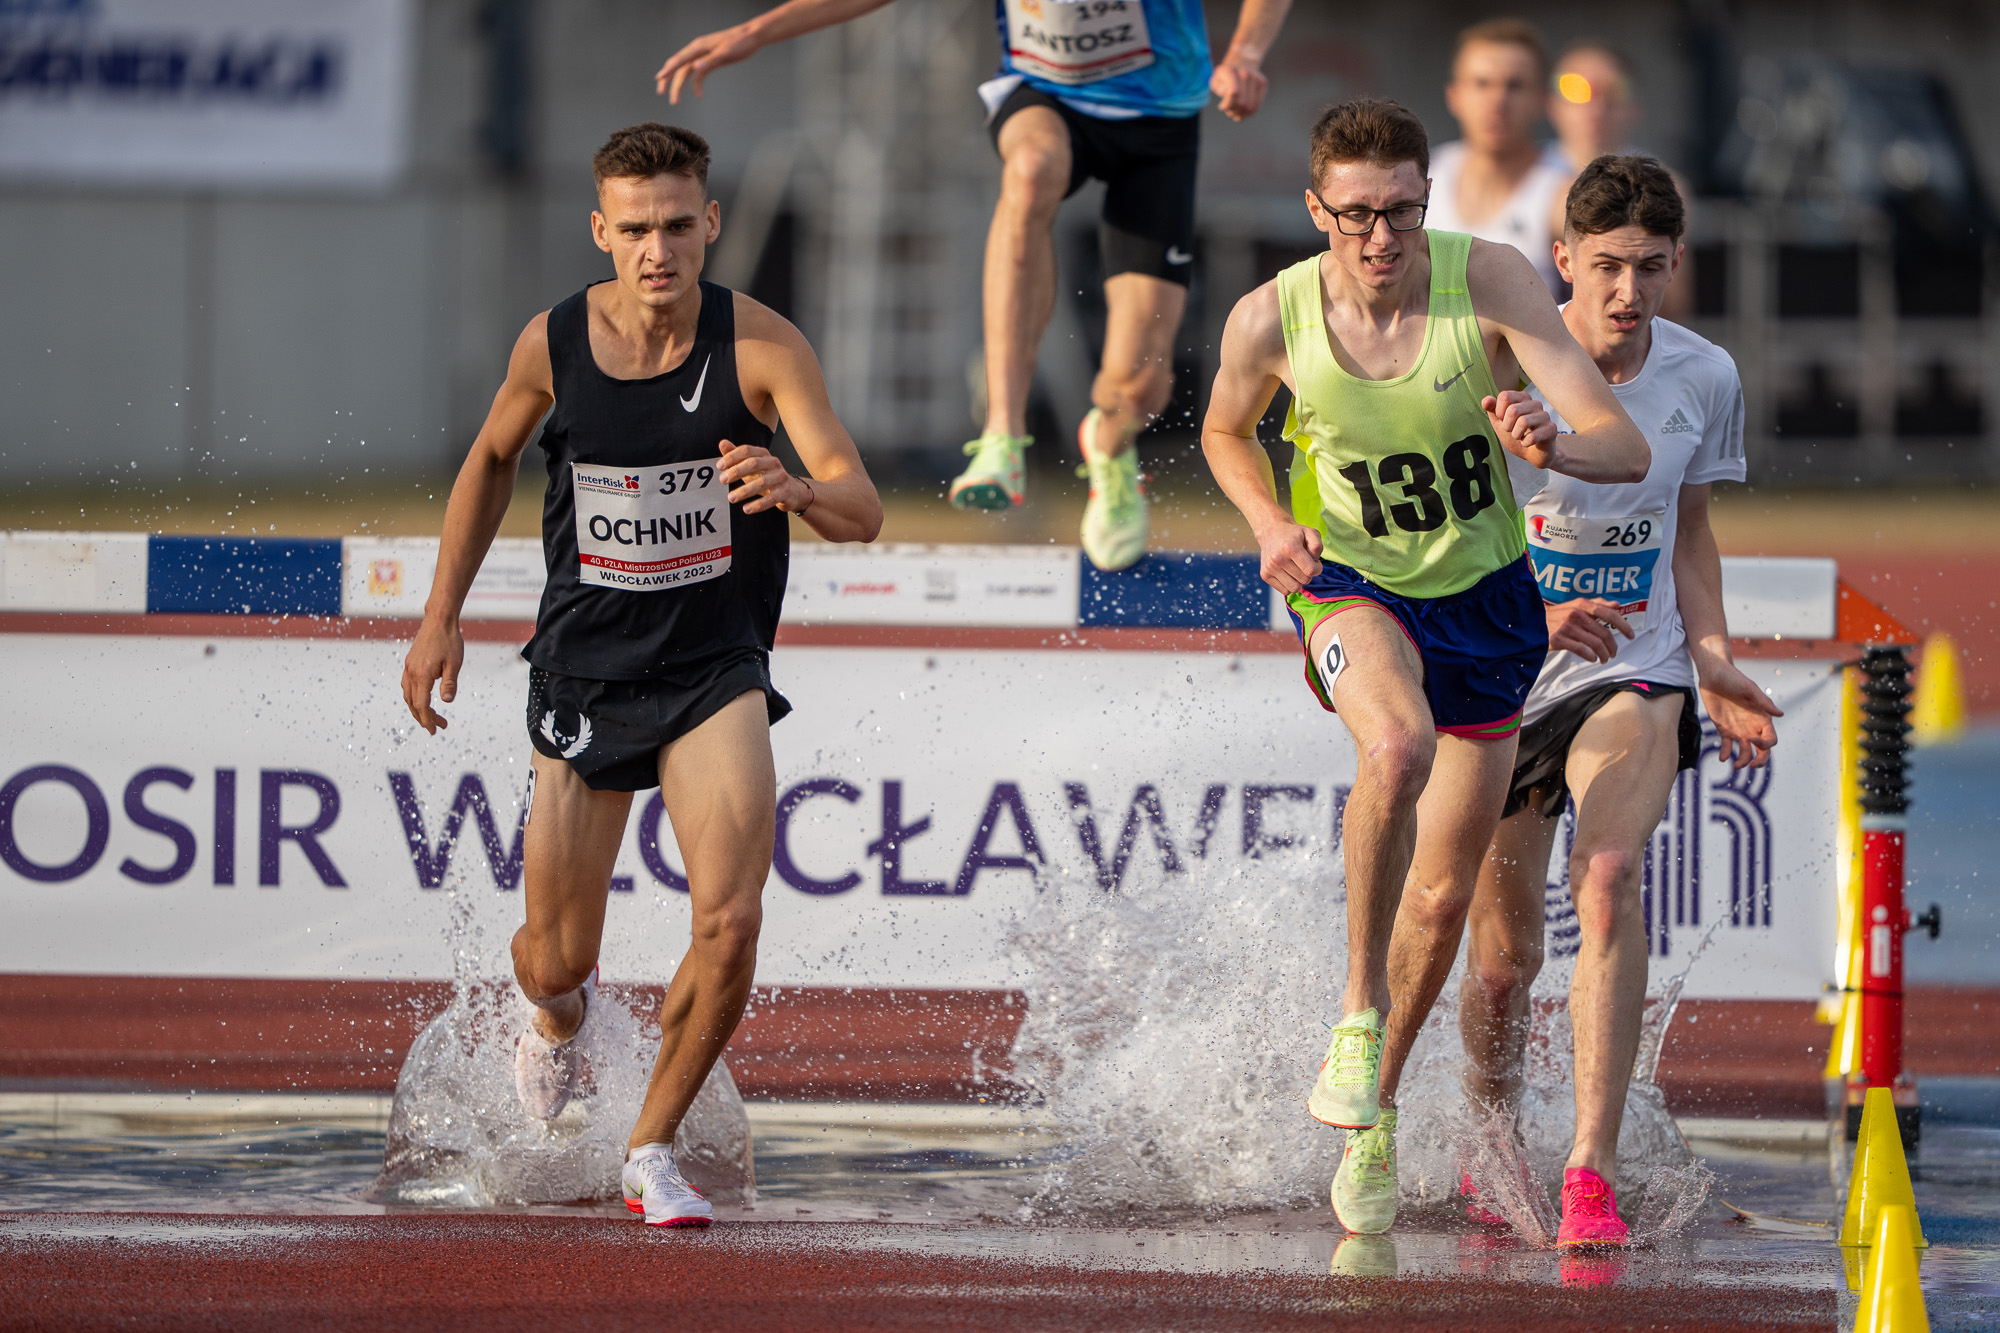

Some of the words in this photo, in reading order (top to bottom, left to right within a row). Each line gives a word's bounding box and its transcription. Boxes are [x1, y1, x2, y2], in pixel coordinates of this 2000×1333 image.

[1023, 24, 1135, 53] ANTOSZ
[1661, 424, 1694, 434] adidas
[577, 472, 624, 488] InterRisk
[658, 465, 715, 495] 379
[1338, 434, 1496, 538] 138
[597, 489, 623, 497] INSURANCE
[589, 507, 717, 546] OCHNIK
[1545, 530, 1578, 541] POMORZE
[1546, 524, 1573, 534] KUJAWY
[1601, 519, 1652, 547] 269
[590, 558, 603, 567] 40.
[604, 559, 623, 570] PZLA
[624, 561, 677, 572] Mistrzostwa
[679, 554, 704, 567] Polski
[705, 550, 722, 560] U23
[600, 570, 681, 586] WŁOCŁAWEK
[683, 564, 713, 580] 2023
[1531, 558, 1641, 594] MEGIER
[0, 762, 350, 888] OSIR
